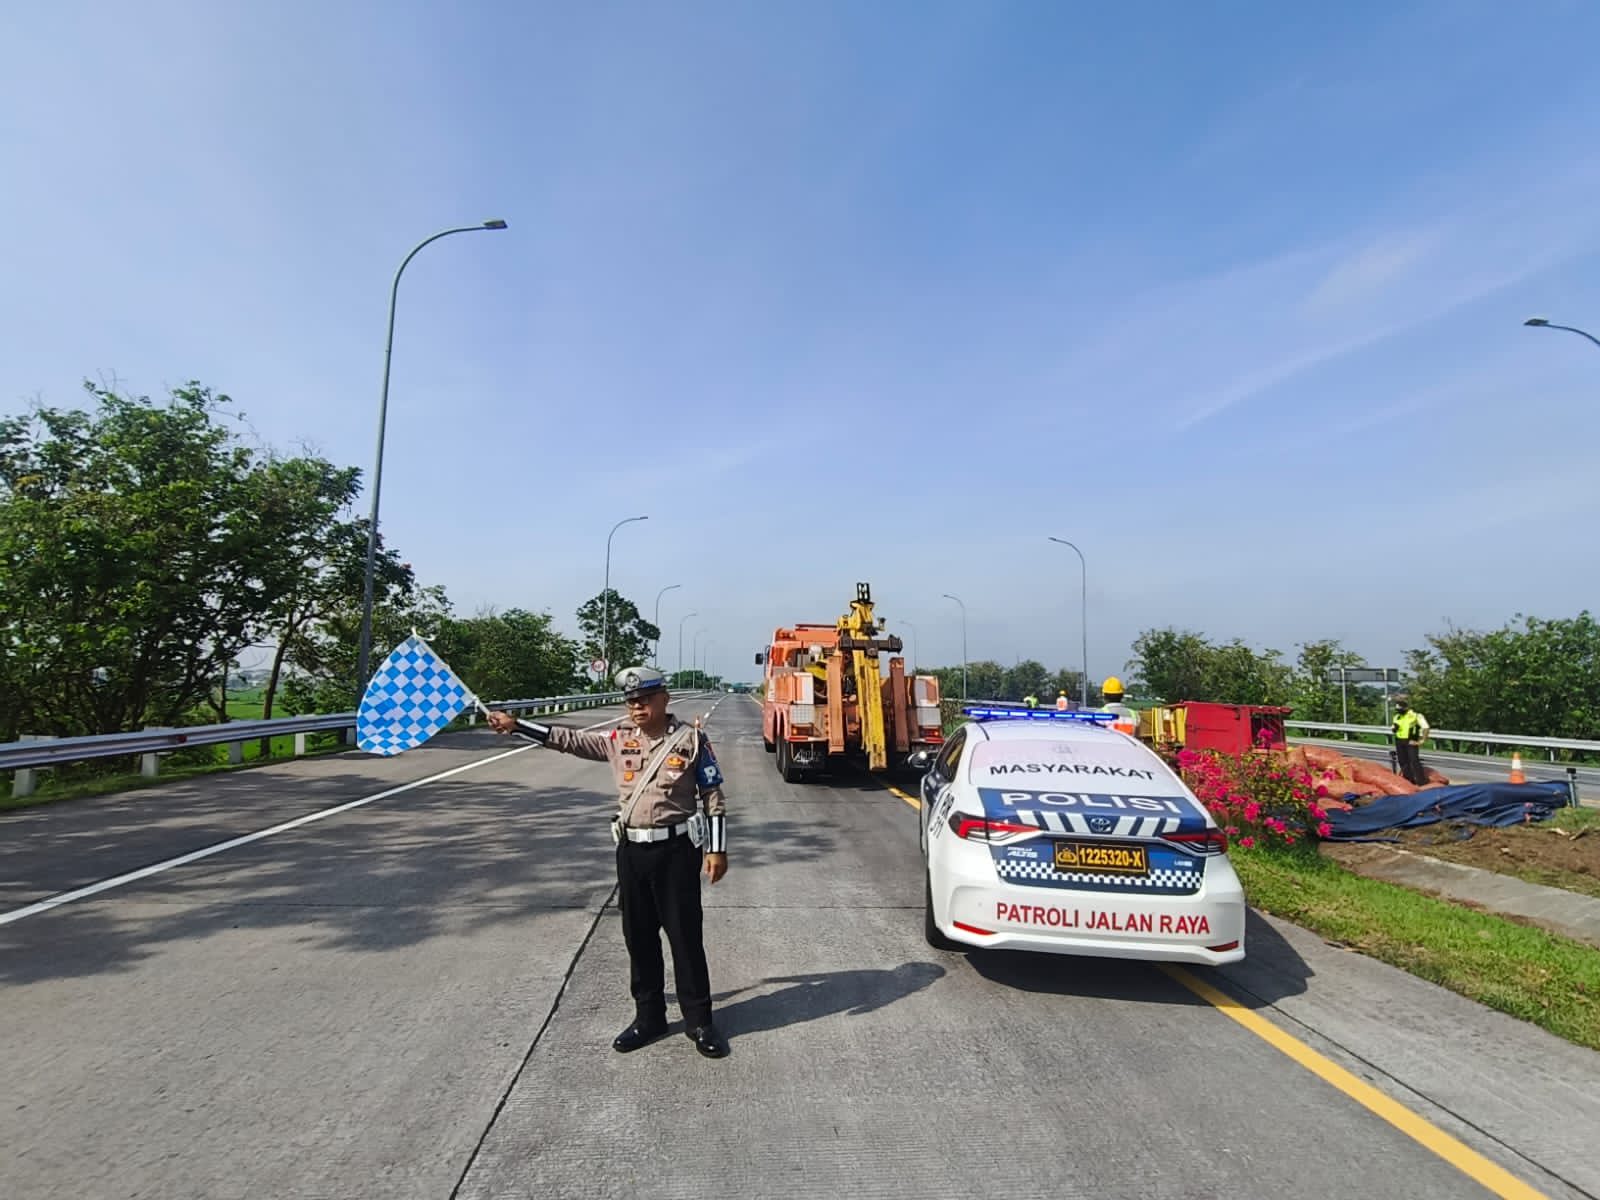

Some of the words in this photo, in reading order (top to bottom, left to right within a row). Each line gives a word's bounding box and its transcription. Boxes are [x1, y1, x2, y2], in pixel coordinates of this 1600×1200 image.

[990, 763, 1155, 781] MASYARAKAT
[1001, 792, 1182, 814] POLISI
[1080, 847, 1142, 867] 1225320-X
[996, 902, 1079, 928] PATROLI
[1086, 910, 1153, 932] JALAN
[1159, 915, 1210, 934] RAYA
